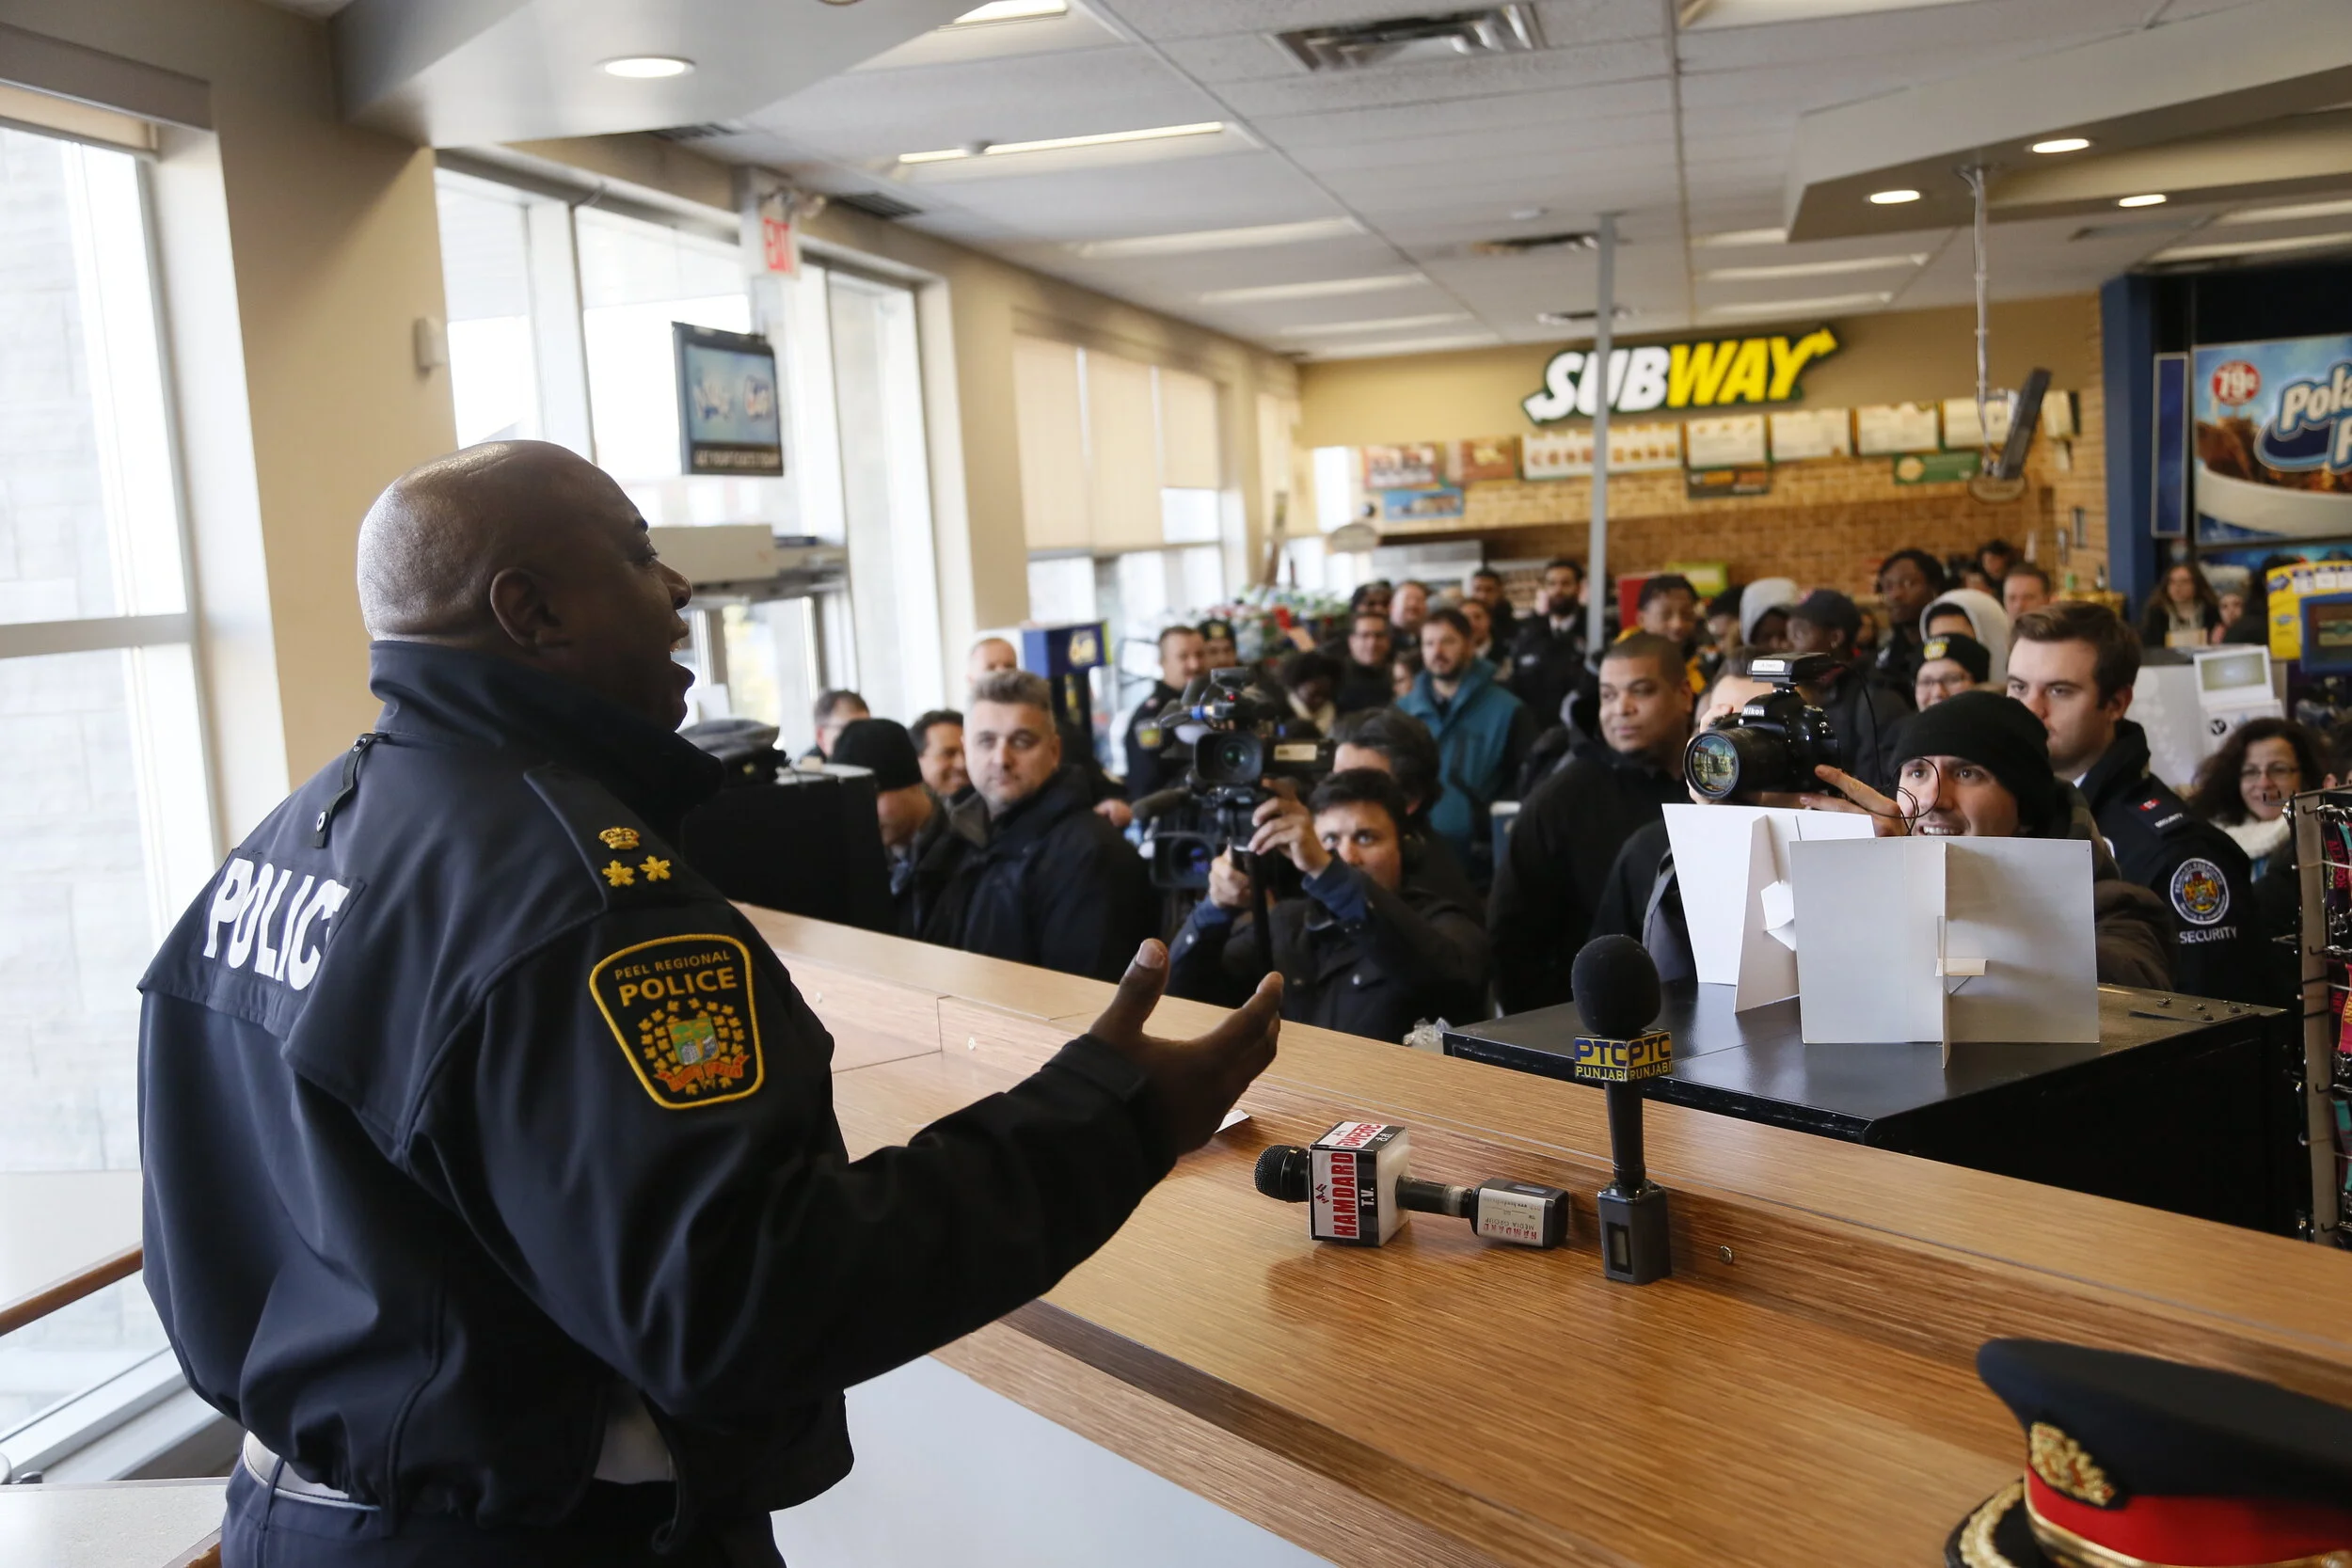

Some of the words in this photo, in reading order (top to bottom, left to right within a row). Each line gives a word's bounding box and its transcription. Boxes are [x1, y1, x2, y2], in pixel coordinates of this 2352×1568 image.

[1523, 328, 1838, 423] SUBWAY
[1742, 707, 1765, 716] Nikon
[203, 858, 351, 990] POLIC
[2179, 927, 2237, 944] SECURITY
[614, 964, 650, 980] PEEL
[655, 950, 731, 972] REGIONAL
[618, 966, 739, 1007] POLICE
[1575, 1038, 1627, 1066] PTC
[1629, 1034, 1672, 1069] PTC
[1330, 1152, 1358, 1237] HAMDARD
[1360, 1186, 1375, 1207] T.V.
[1486, 1217, 1510, 1226] GROUP
[1512, 1222, 1534, 1230] MEDIA
